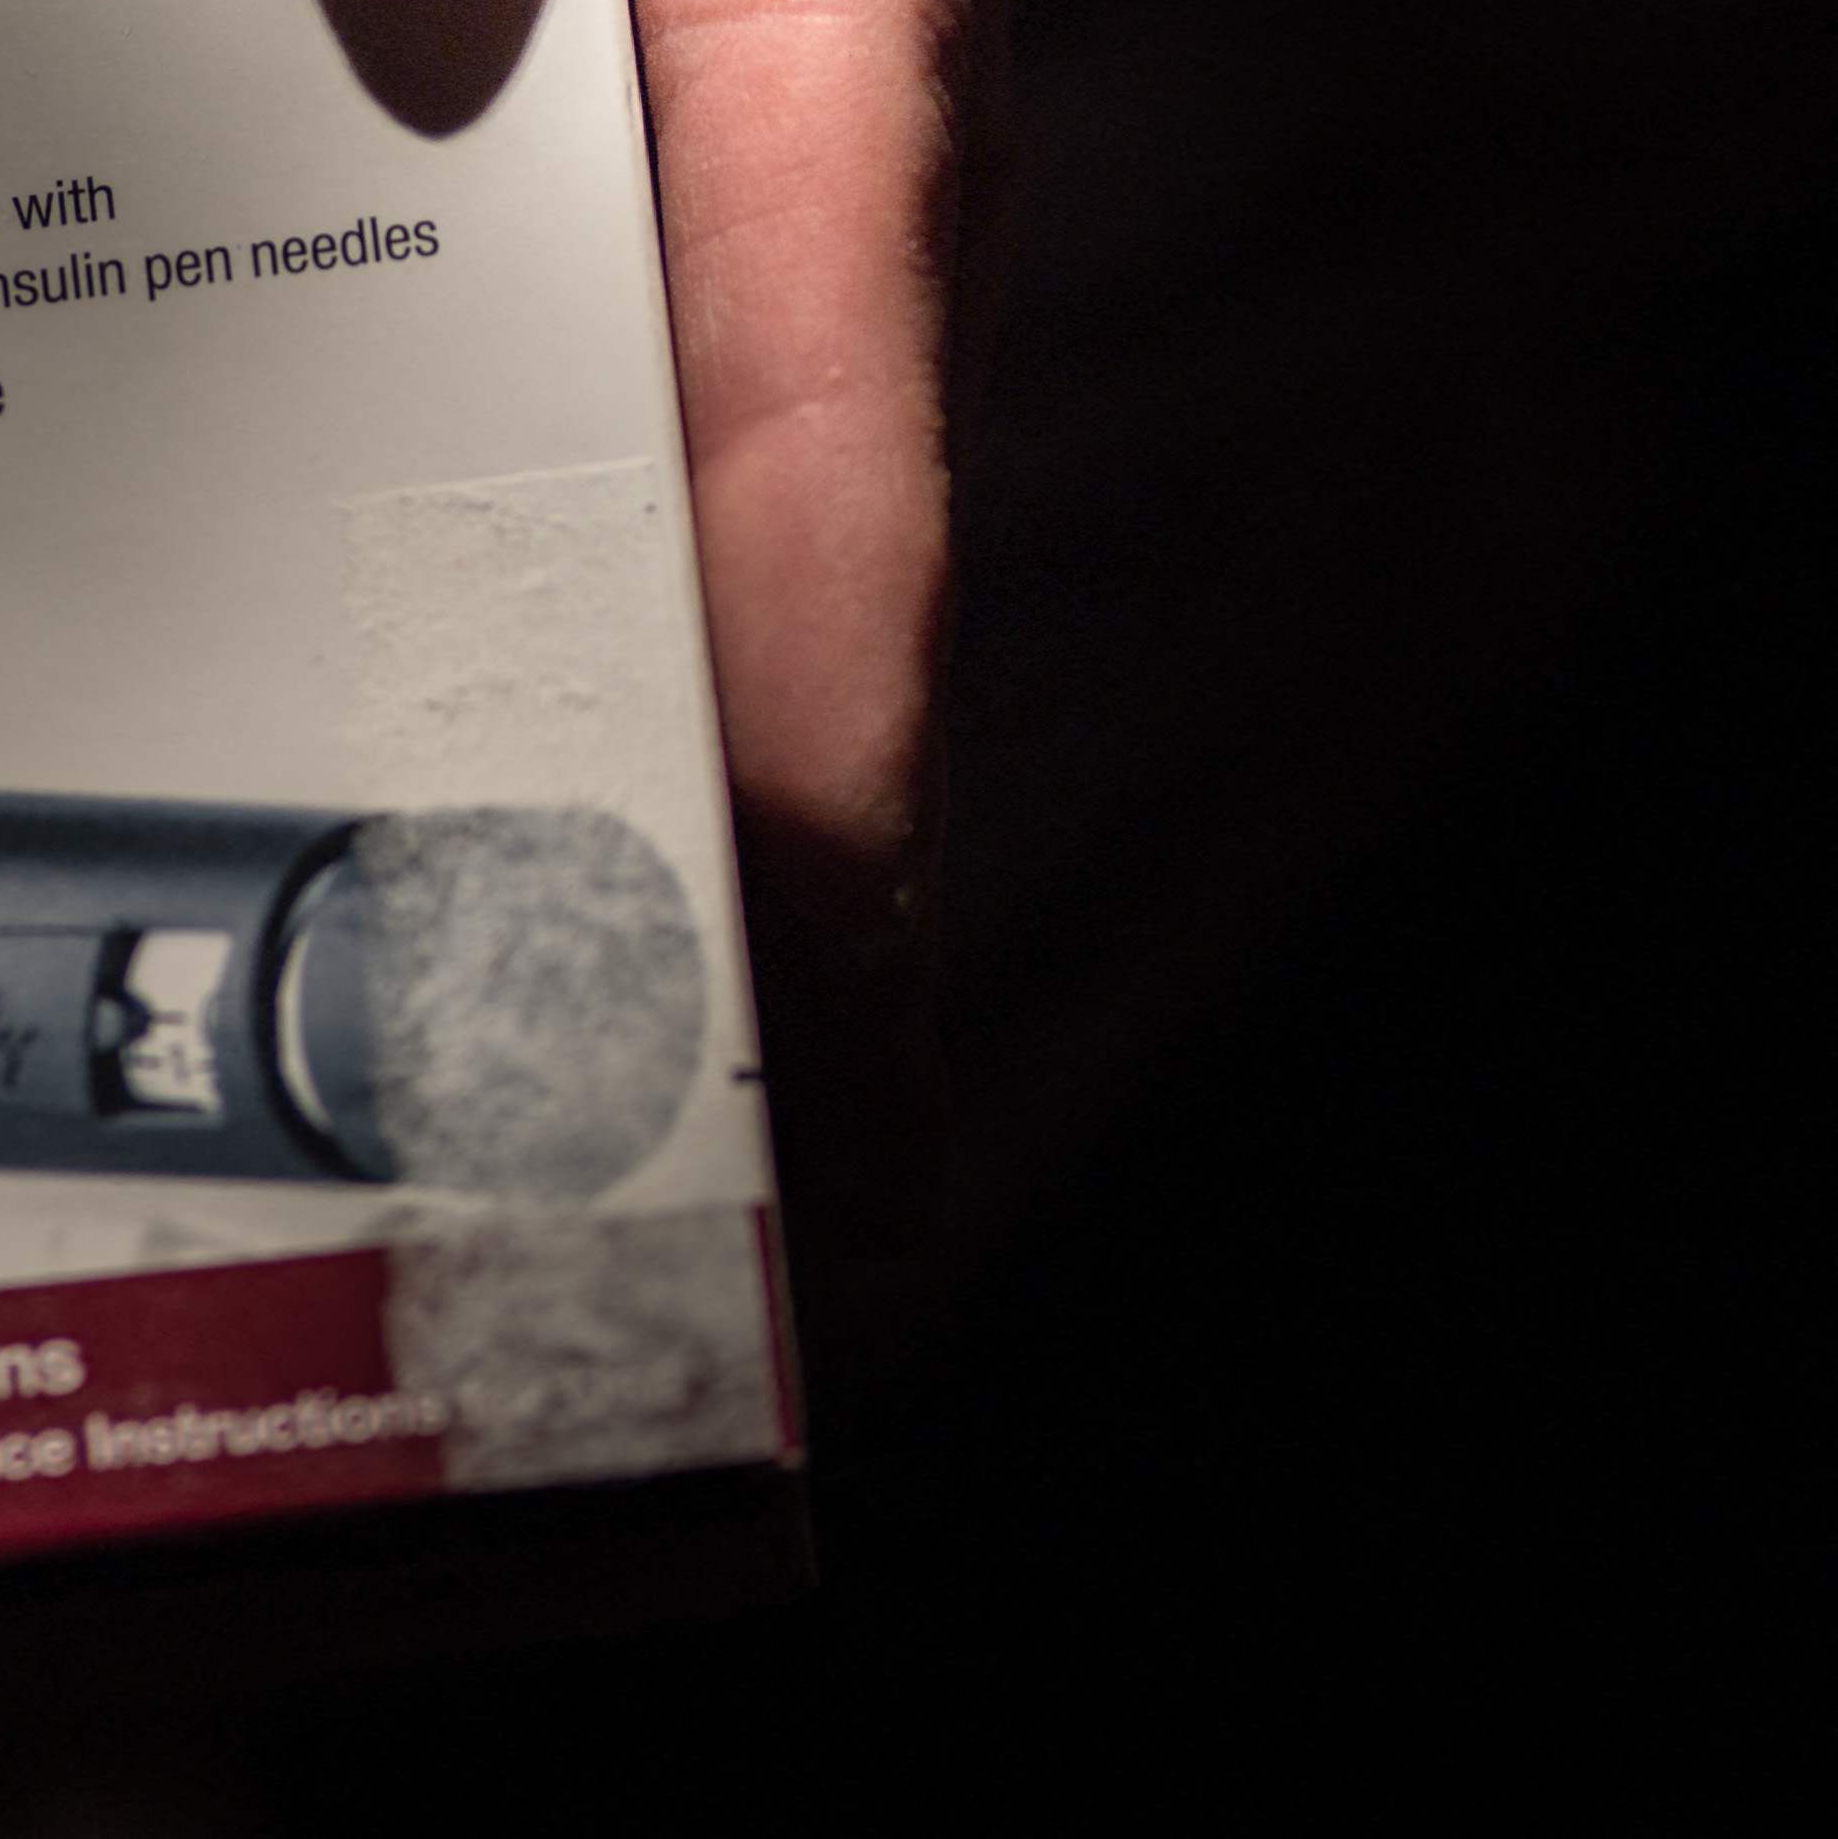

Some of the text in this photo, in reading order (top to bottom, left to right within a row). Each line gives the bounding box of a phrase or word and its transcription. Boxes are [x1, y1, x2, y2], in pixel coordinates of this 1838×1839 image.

[13, 176, 116, 231] with
[145, 245, 233, 301] pen
[251, 217, 440, 277] needles
[84, 1388, 449, 1472] Instructions
